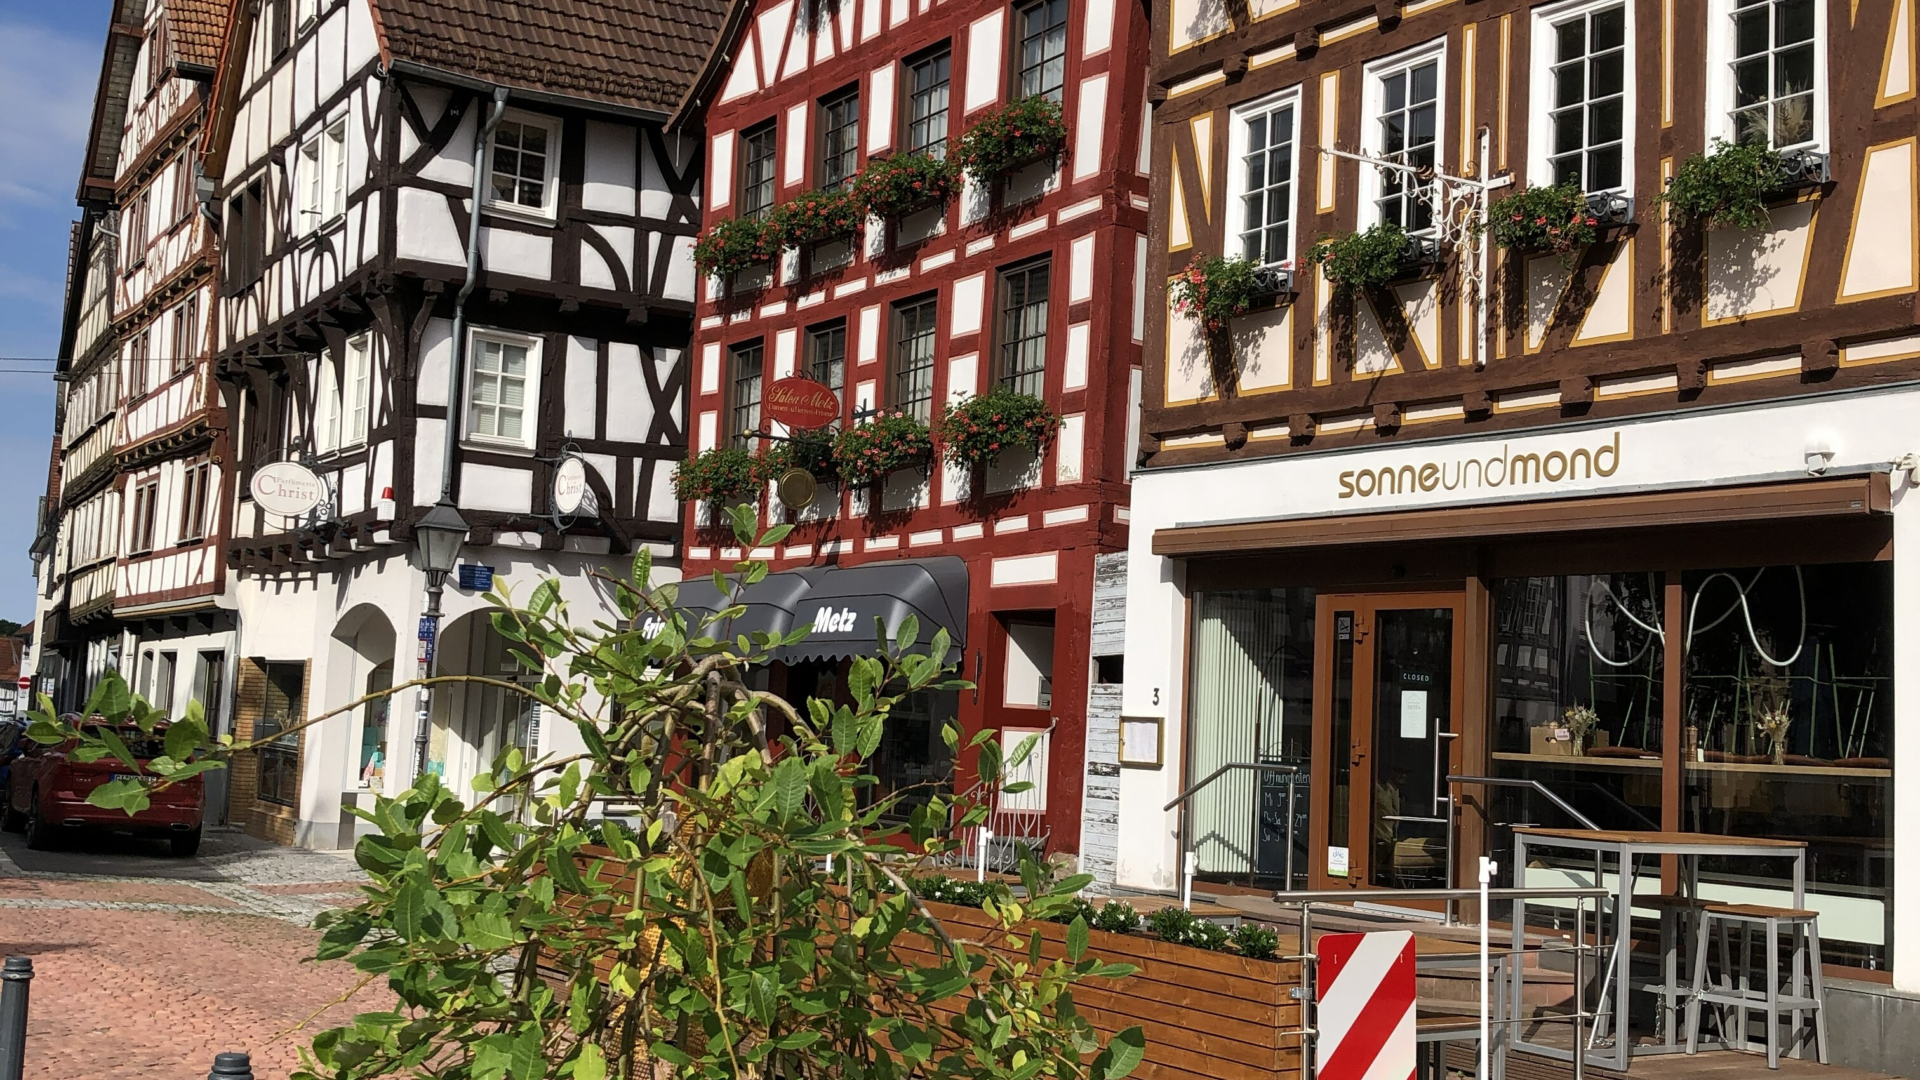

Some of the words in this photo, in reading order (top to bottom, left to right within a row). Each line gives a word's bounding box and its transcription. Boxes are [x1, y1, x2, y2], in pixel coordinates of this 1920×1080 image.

[768, 386, 799, 404] Salon
[801, 391, 835, 409] Metz
[1338, 431, 1620, 498] sonneundmond
[258, 474, 315, 501] Christ
[276, 476, 316, 488] Parfümerie
[557, 474, 582, 496] Christ
[812, 606, 858, 633] Metz
[1403, 673, 1429, 681] CLOSED
[1152, 687, 1160, 706] 3
